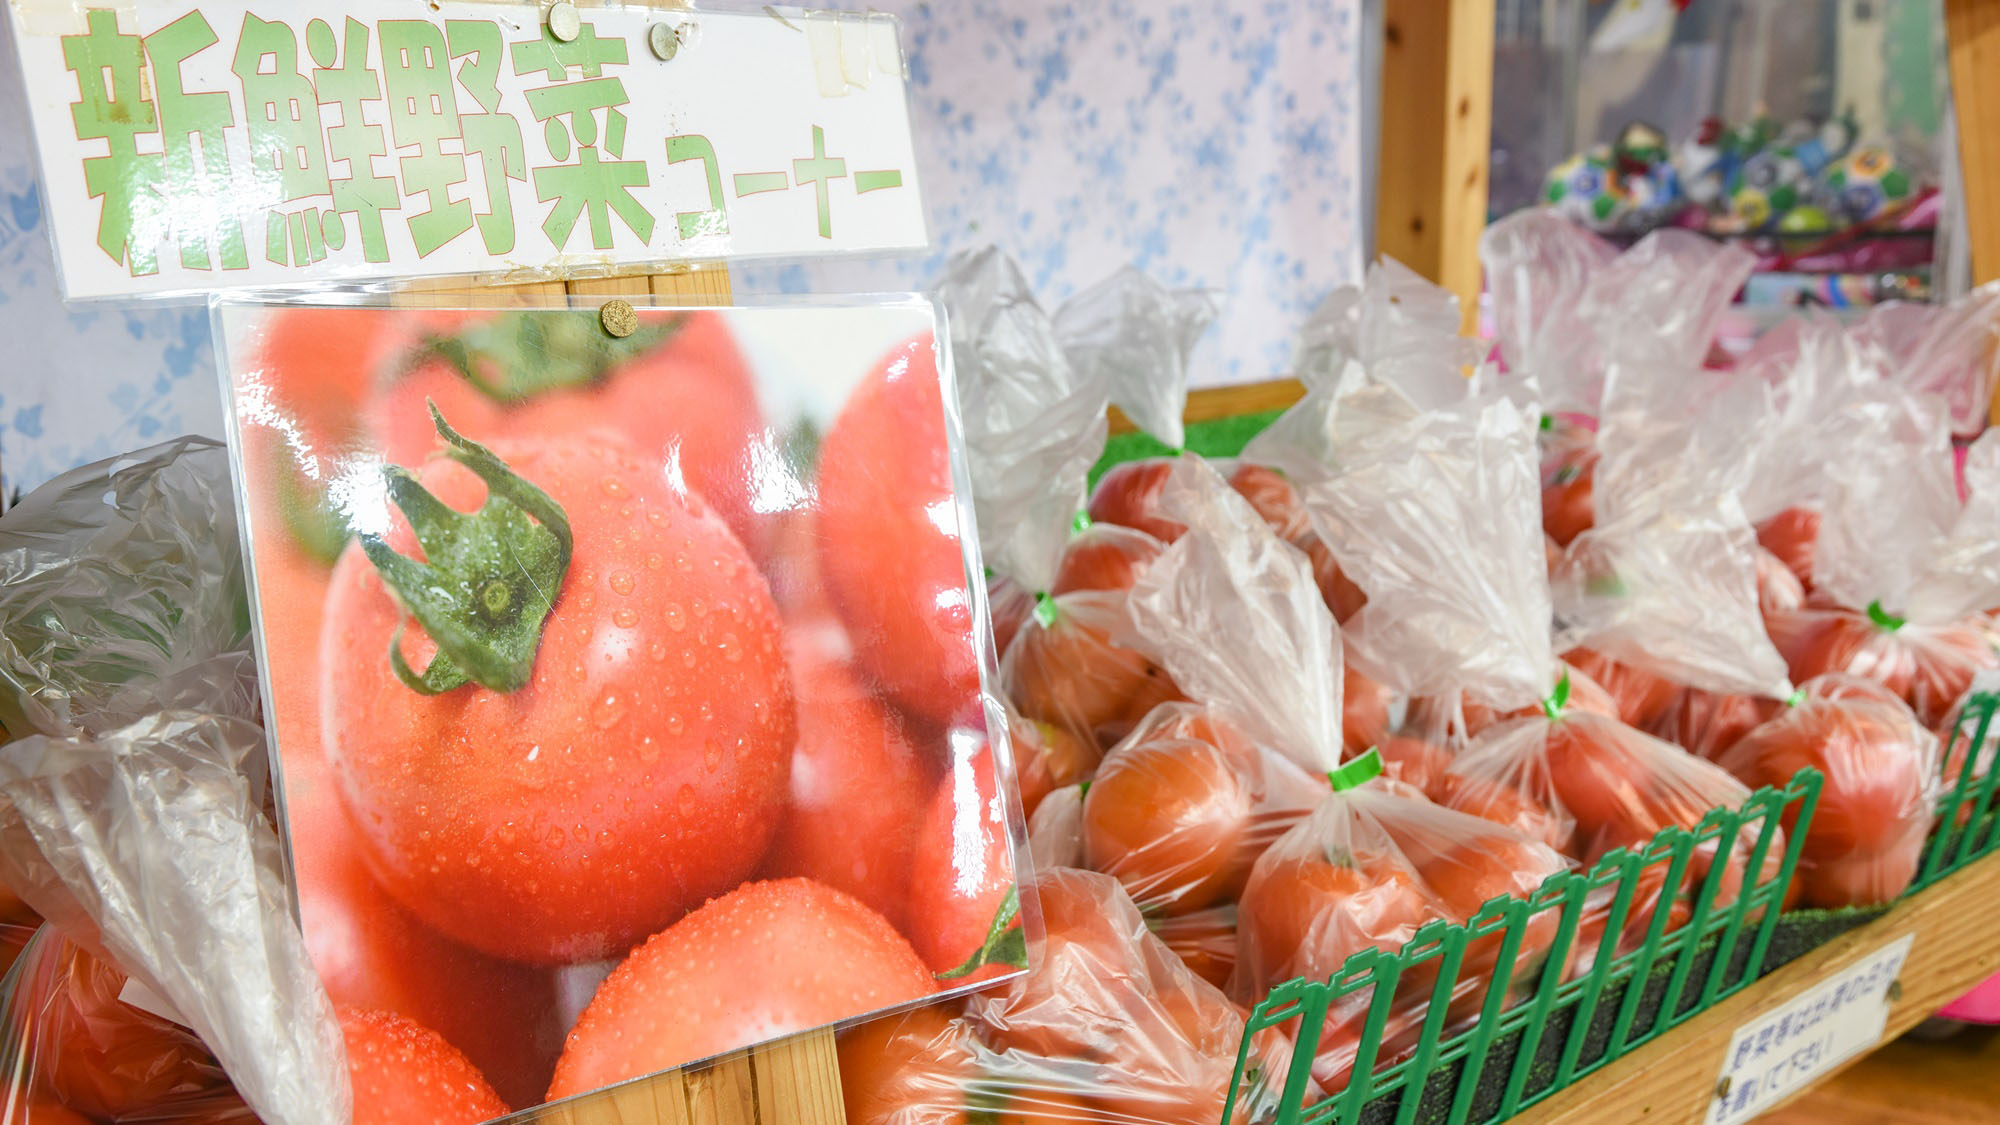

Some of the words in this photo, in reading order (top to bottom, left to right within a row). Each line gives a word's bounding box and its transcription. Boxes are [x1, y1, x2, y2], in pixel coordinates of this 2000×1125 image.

[60, 8, 904, 277] 新鮮野菜コーナー
